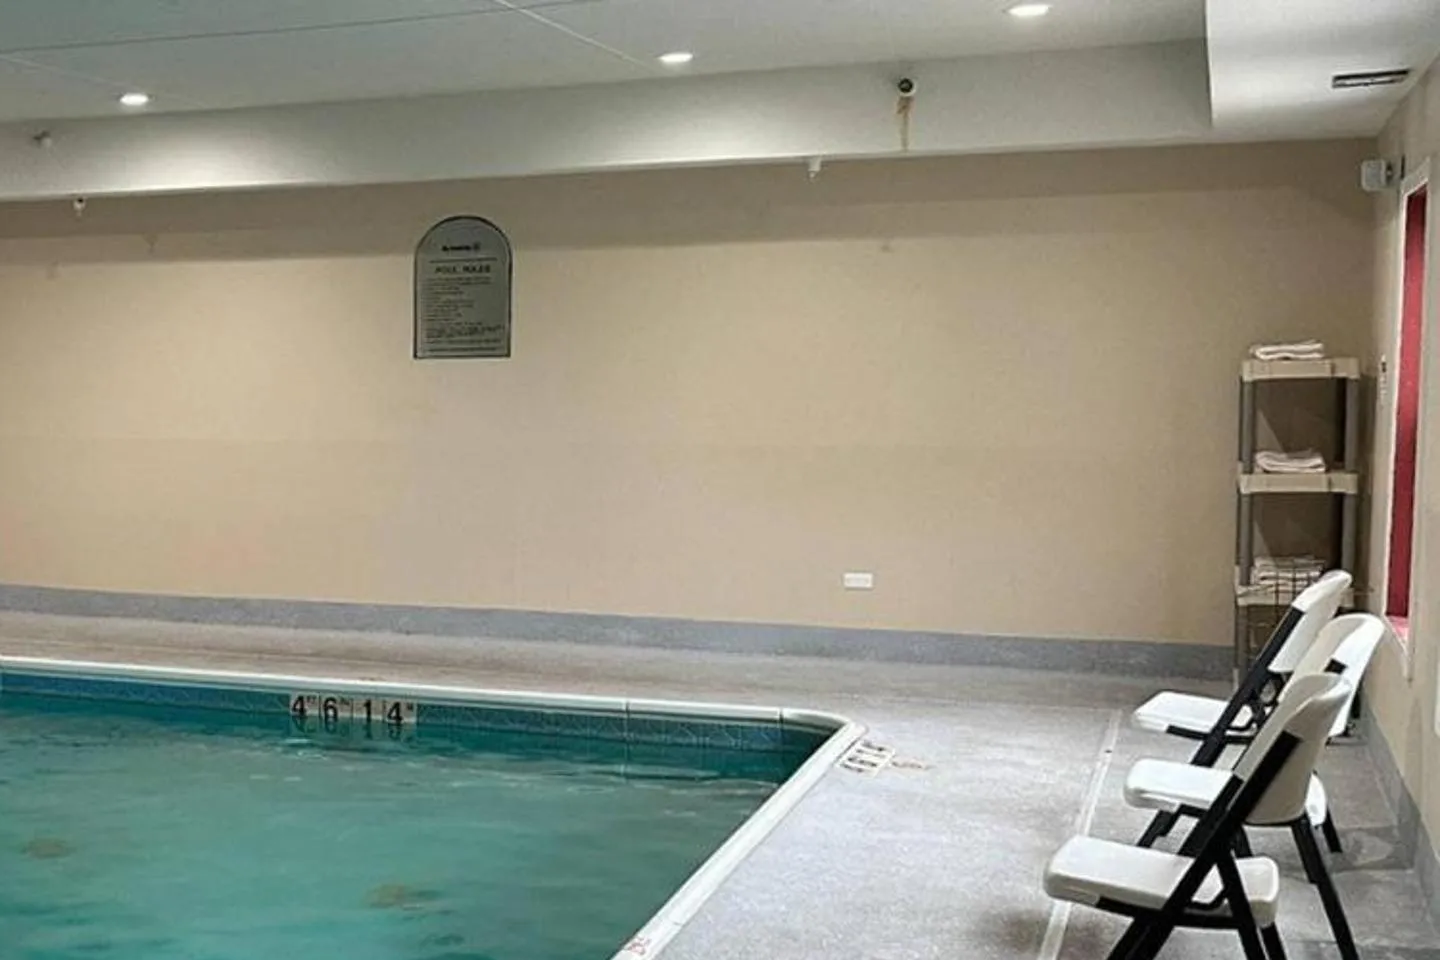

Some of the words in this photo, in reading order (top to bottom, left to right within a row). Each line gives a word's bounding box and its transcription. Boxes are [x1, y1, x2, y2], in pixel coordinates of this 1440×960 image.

[292, 695, 307, 716] 4
[323, 696, 338, 719] 6
[363, 698, 372, 719] 1
[387, 701, 403, 722] 4
